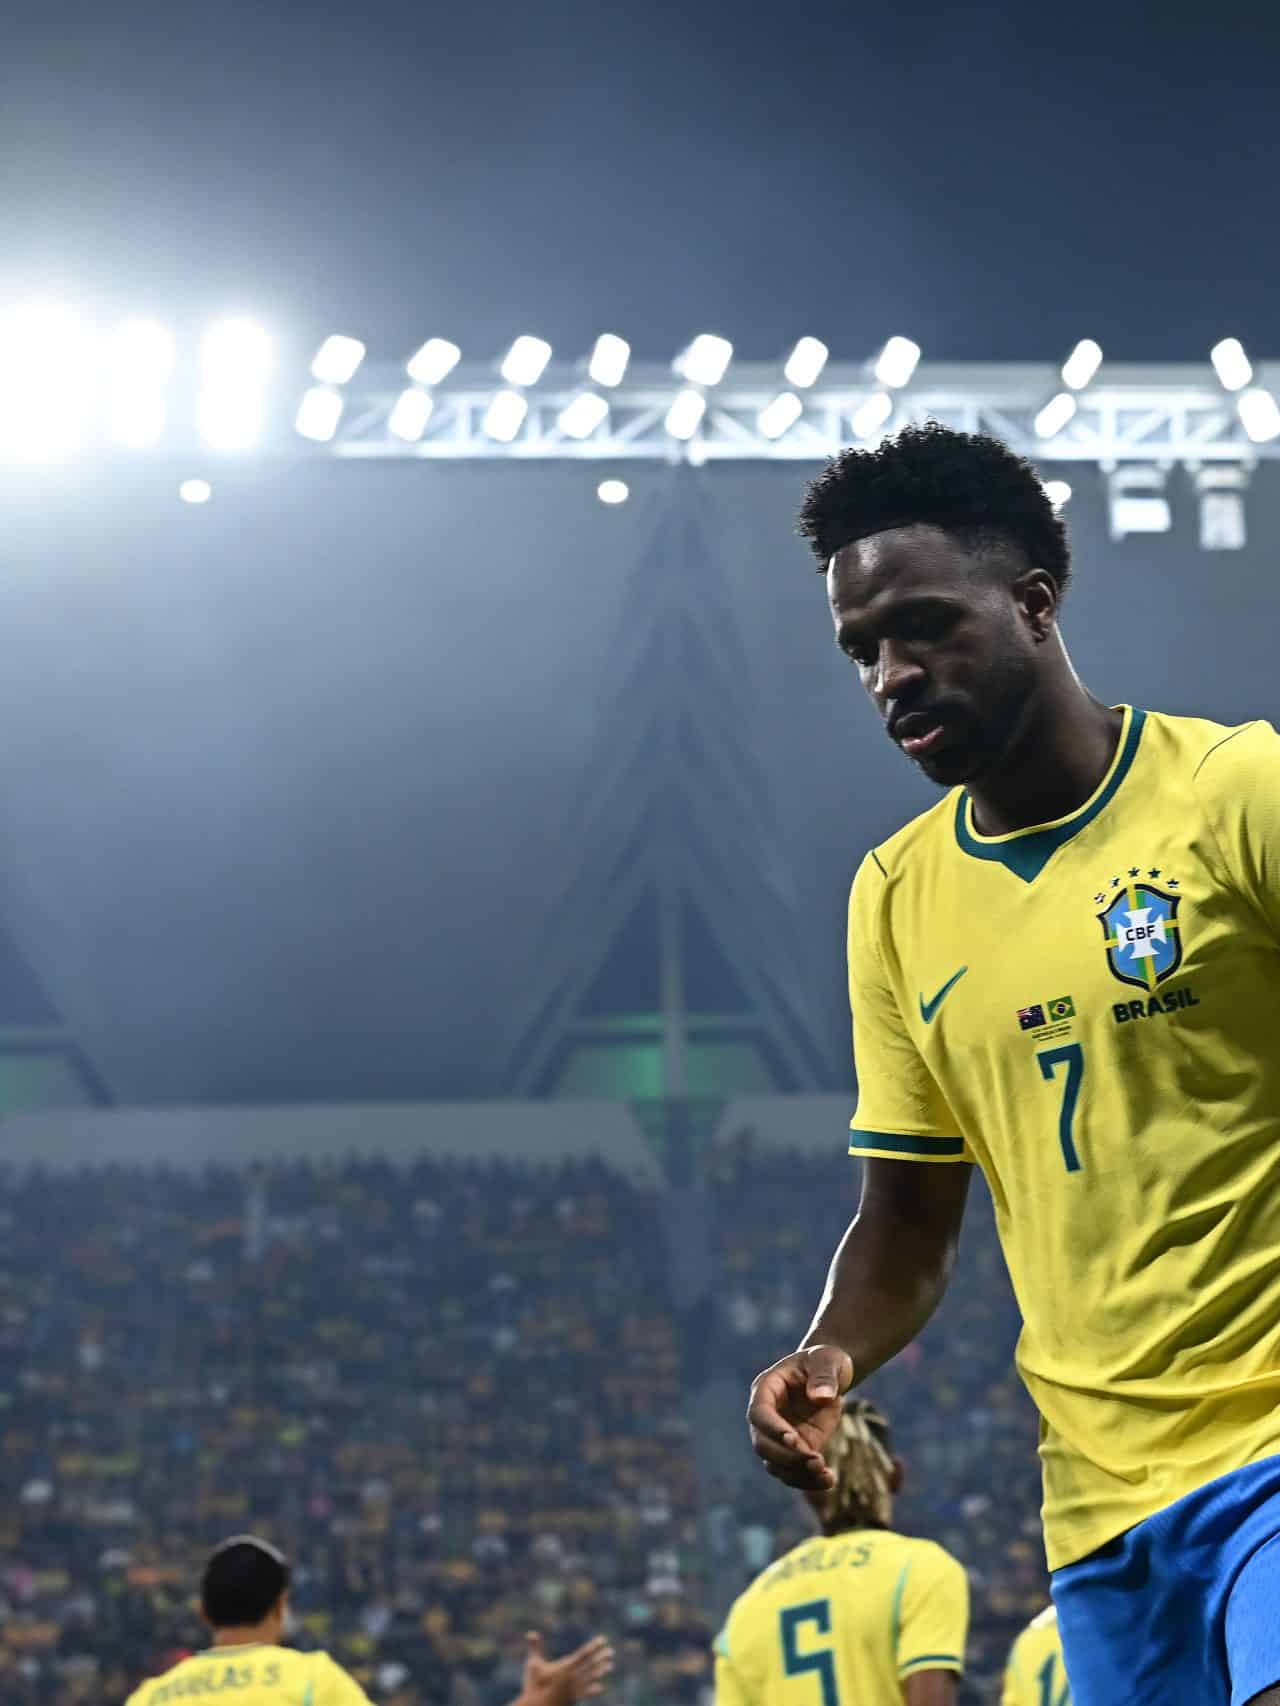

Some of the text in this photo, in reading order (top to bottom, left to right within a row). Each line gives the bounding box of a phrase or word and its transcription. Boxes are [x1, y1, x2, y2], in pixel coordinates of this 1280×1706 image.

[1125, 925, 1156, 942] CBF
[1112, 987, 1201, 1024] BRASIL
[1036, 1043, 1085, 1173] 7
[778, 1598, 840, 1706] 5
